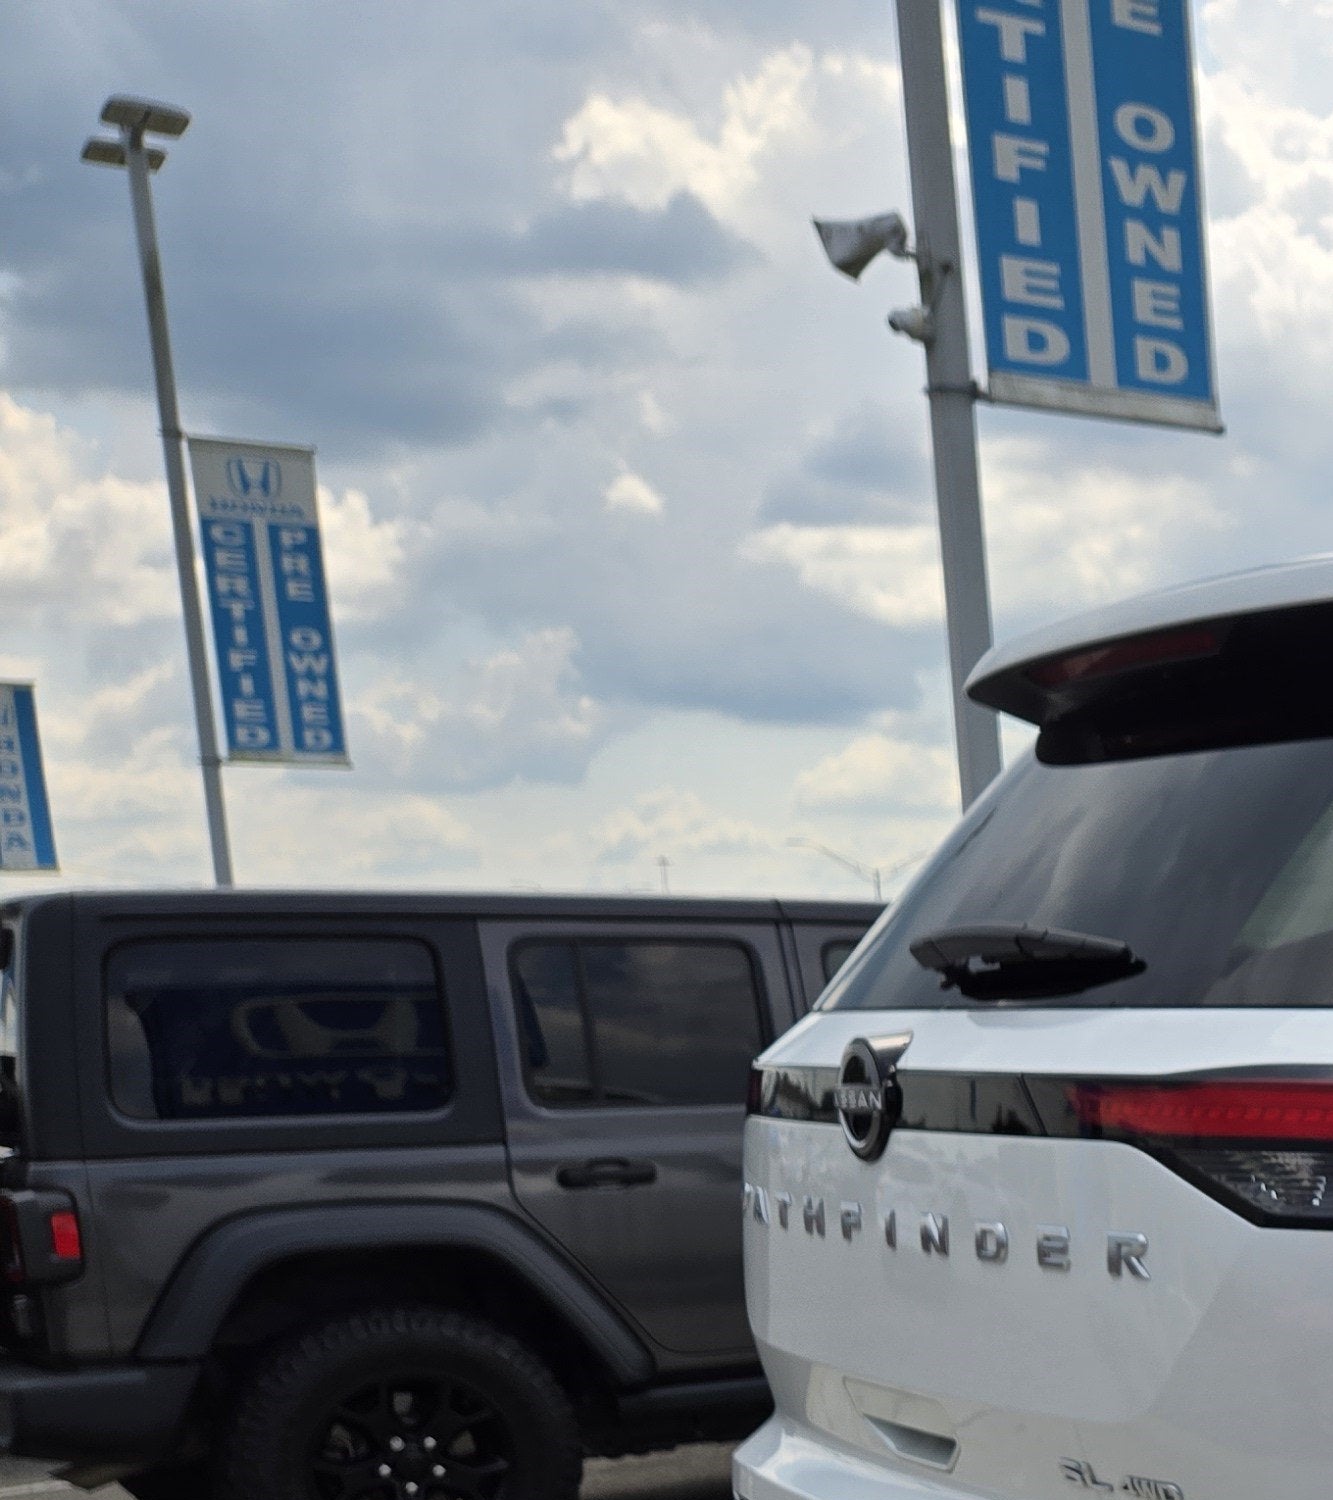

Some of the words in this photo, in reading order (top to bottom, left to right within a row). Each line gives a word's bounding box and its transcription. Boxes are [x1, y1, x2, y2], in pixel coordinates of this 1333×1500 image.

[975, 0, 1071, 367] TIFIED
[1107, 102, 1189, 386] OWNED
[208, 522, 271, 748] CERTIFIED
[278, 528, 315, 603] PRE
[287, 625, 334, 750] OWNED
[1058, 1456, 1115, 1493] SL
